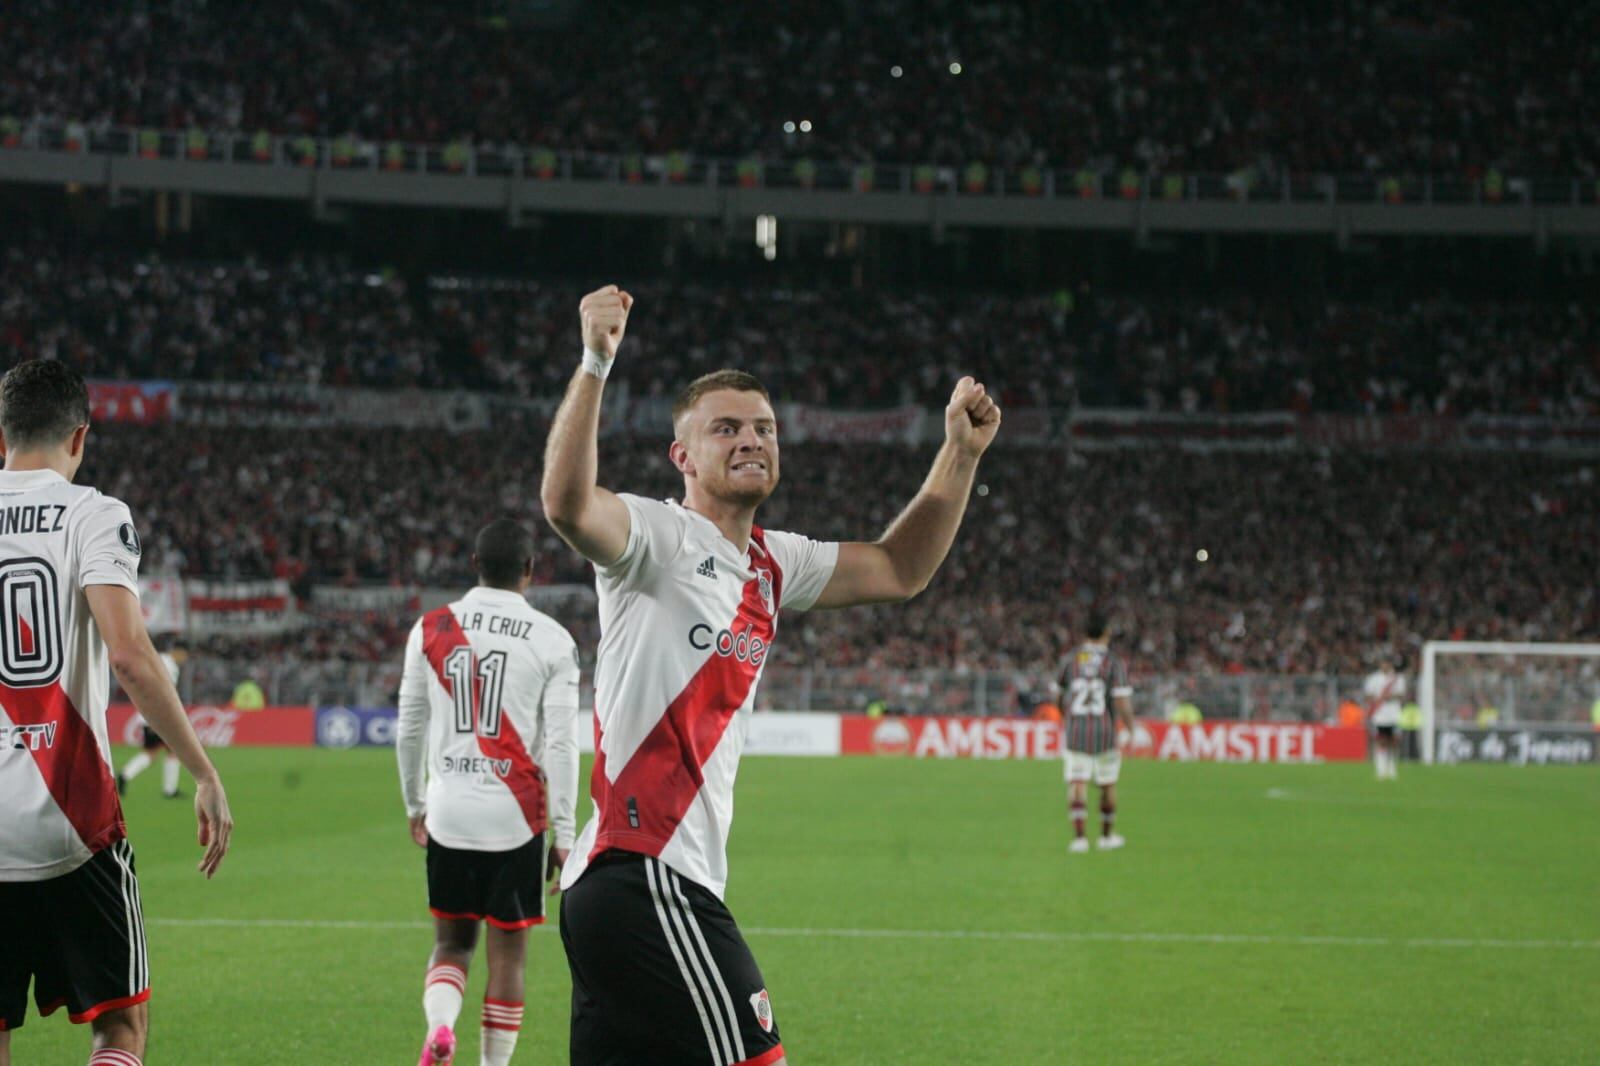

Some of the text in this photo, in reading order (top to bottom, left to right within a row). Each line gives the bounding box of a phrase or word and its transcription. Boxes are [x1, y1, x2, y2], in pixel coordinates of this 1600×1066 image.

[462, 612, 483, 631] LA
[488, 615, 534, 640] CRUZ
[445, 647, 508, 737] 11
[1070, 678, 1106, 715] 23
[915, 719, 1067, 760] AMSTE
[1156, 722, 1325, 762] AMSTEL
[443, 756, 512, 777] DIRECTV
